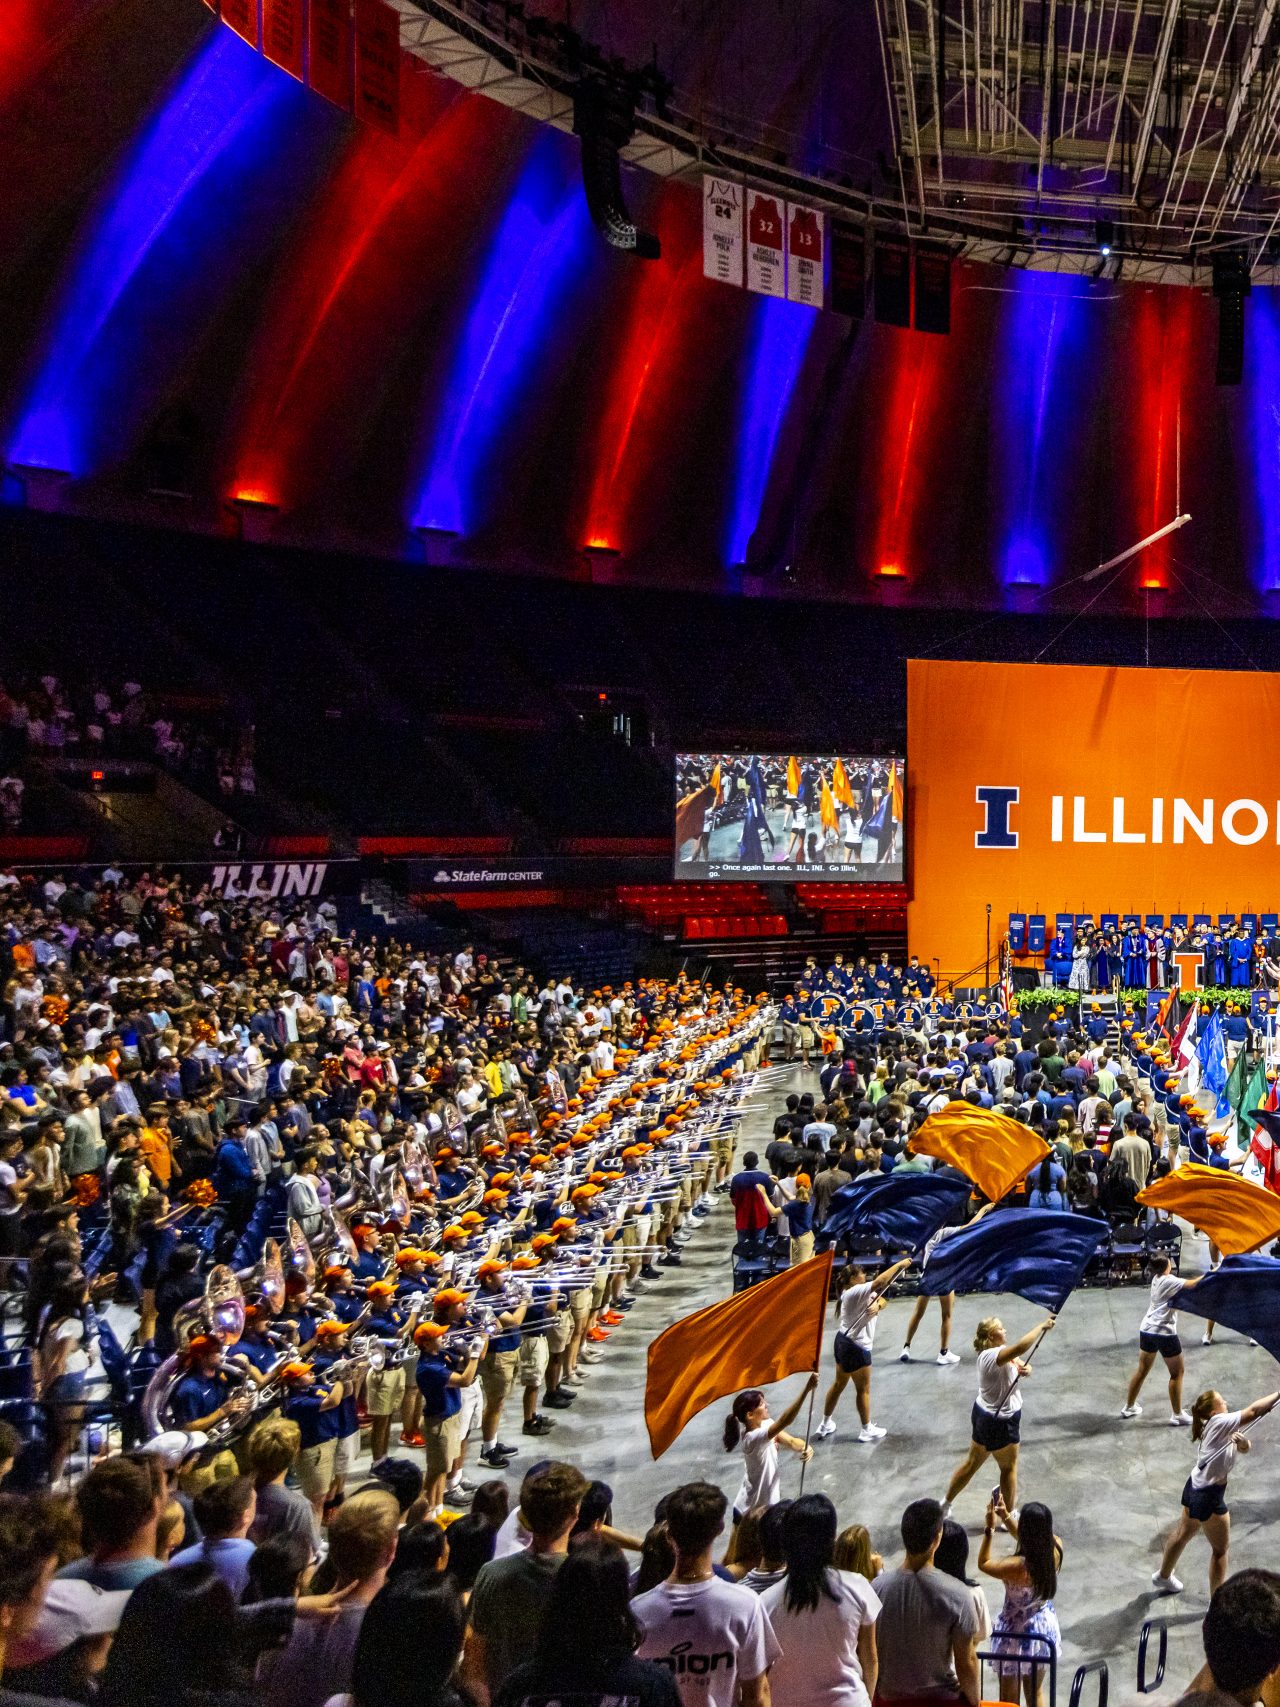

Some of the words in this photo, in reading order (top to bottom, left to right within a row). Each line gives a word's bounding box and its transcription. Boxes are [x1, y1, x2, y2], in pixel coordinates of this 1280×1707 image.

[715, 205, 731, 219] 24
[760, 219, 774, 234] 32
[799, 232, 812, 246] 13
[975, 786, 1020, 849] I
[508, 872, 542, 880] CENTER
[1172, 952, 1205, 993] I
